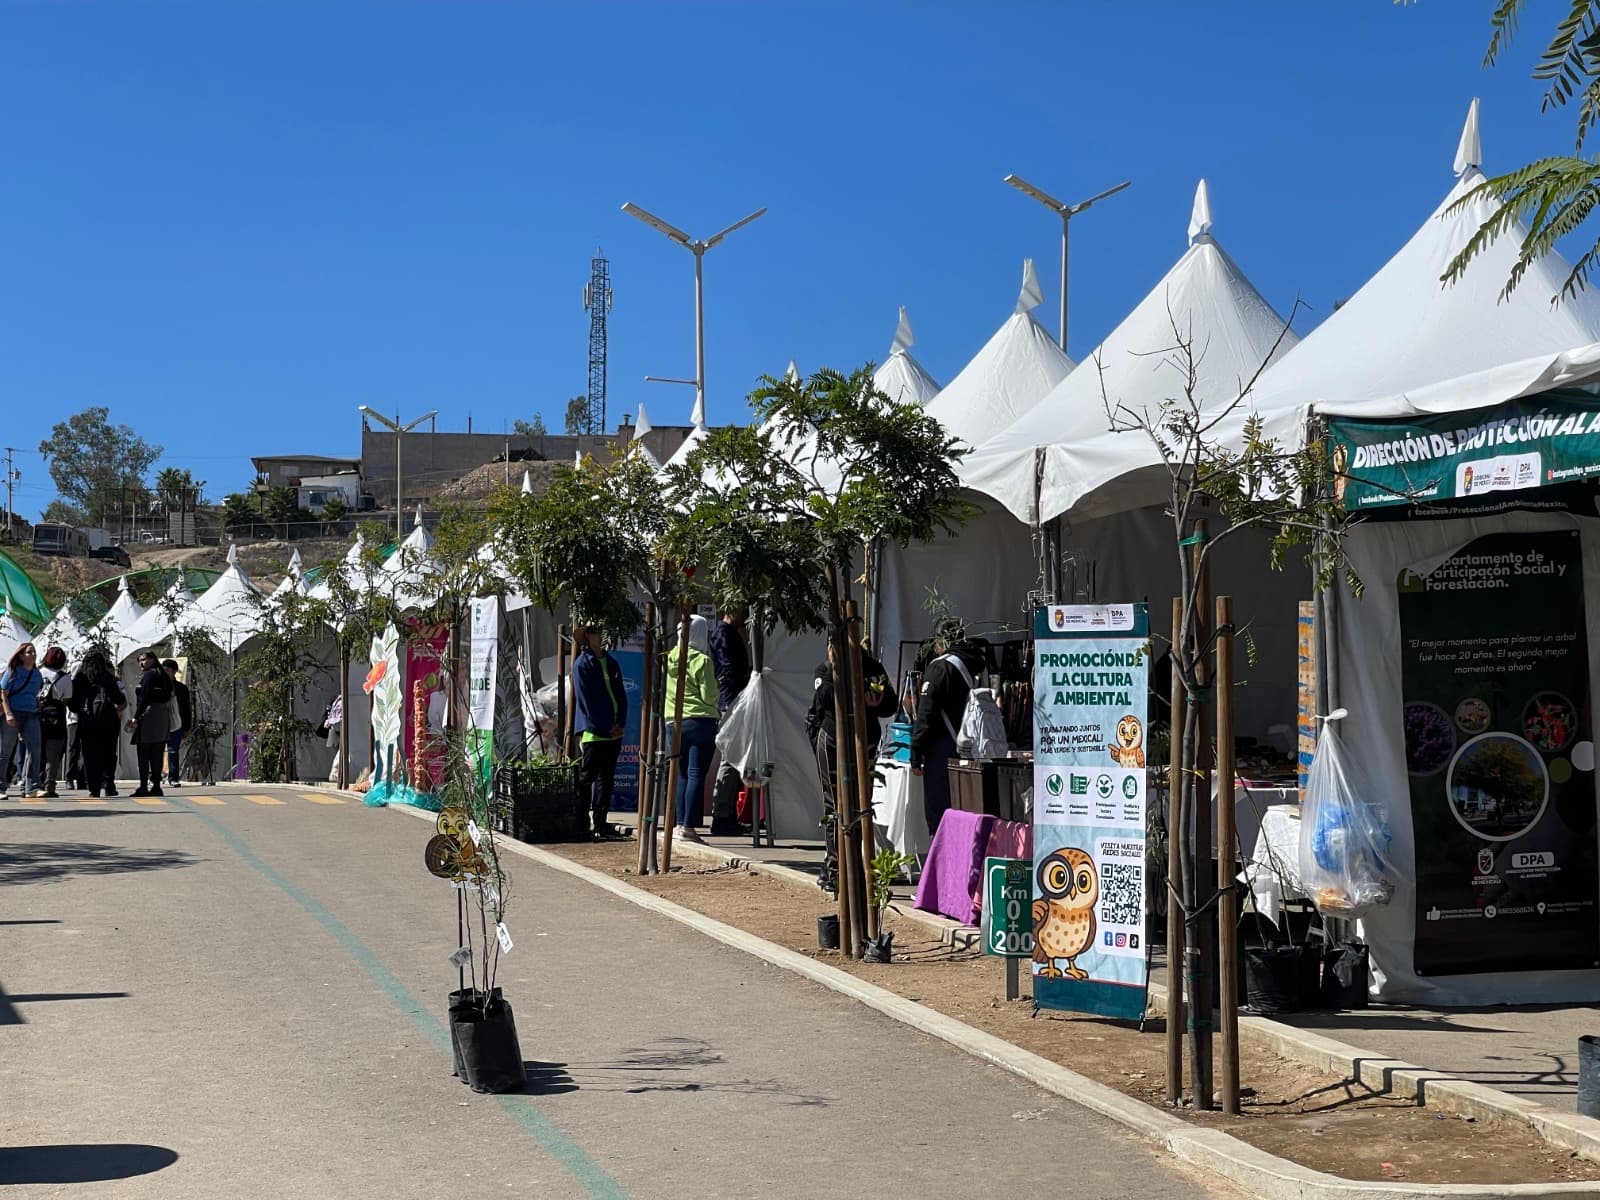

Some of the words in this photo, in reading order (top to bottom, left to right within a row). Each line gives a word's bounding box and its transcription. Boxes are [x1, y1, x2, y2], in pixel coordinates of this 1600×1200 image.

[1352, 431, 1432, 469] DIRECCIÓN
[1430, 430, 1456, 458] DE
[1554, 411, 1587, 436] AL
[1443, 552, 1523, 569] partamento
[1526, 549, 1544, 563] de
[1434, 564, 1511, 580] articipacón
[1513, 560, 1554, 576] Social
[1557, 564, 1568, 577] y
[1425, 576, 1509, 592] Forestación.
[1421, 639, 1446, 649] mejor
[1447, 638, 1488, 647] momento
[1488, 637, 1509, 647] para
[1511, 634, 1542, 645] plantar
[1040, 649, 1124, 668] PROMOCIÓN
[1125, 653, 1143, 667] DE
[1418, 652, 1433, 662] fue
[1435, 650, 1456, 661] hace
[1458, 650, 1471, 660] 20
[1497, 649, 1506, 658] El
[1507, 648, 1543, 660] segundo
[1545, 648, 1569, 659] mejor
[1454, 664, 1495, 674] momento
[1052, 672, 1070, 686] LA
[1071, 672, 1133, 687] CULTURA
[1053, 691, 1132, 706] AMBIENTAL
[1040, 725, 1078, 734] TRABAJANDO
[1040, 735, 1056, 745] POR
[1057, 735, 1070, 745] UN
[1071, 733, 1104, 744] MEXICALI
[1120, 850, 1142, 858] SOCIALES
[1520, 854, 1546, 866] DPA
[1001, 885, 1027, 899] Km
[1006, 899, 1021, 921] 0
[995, 930, 1032, 951] 200
